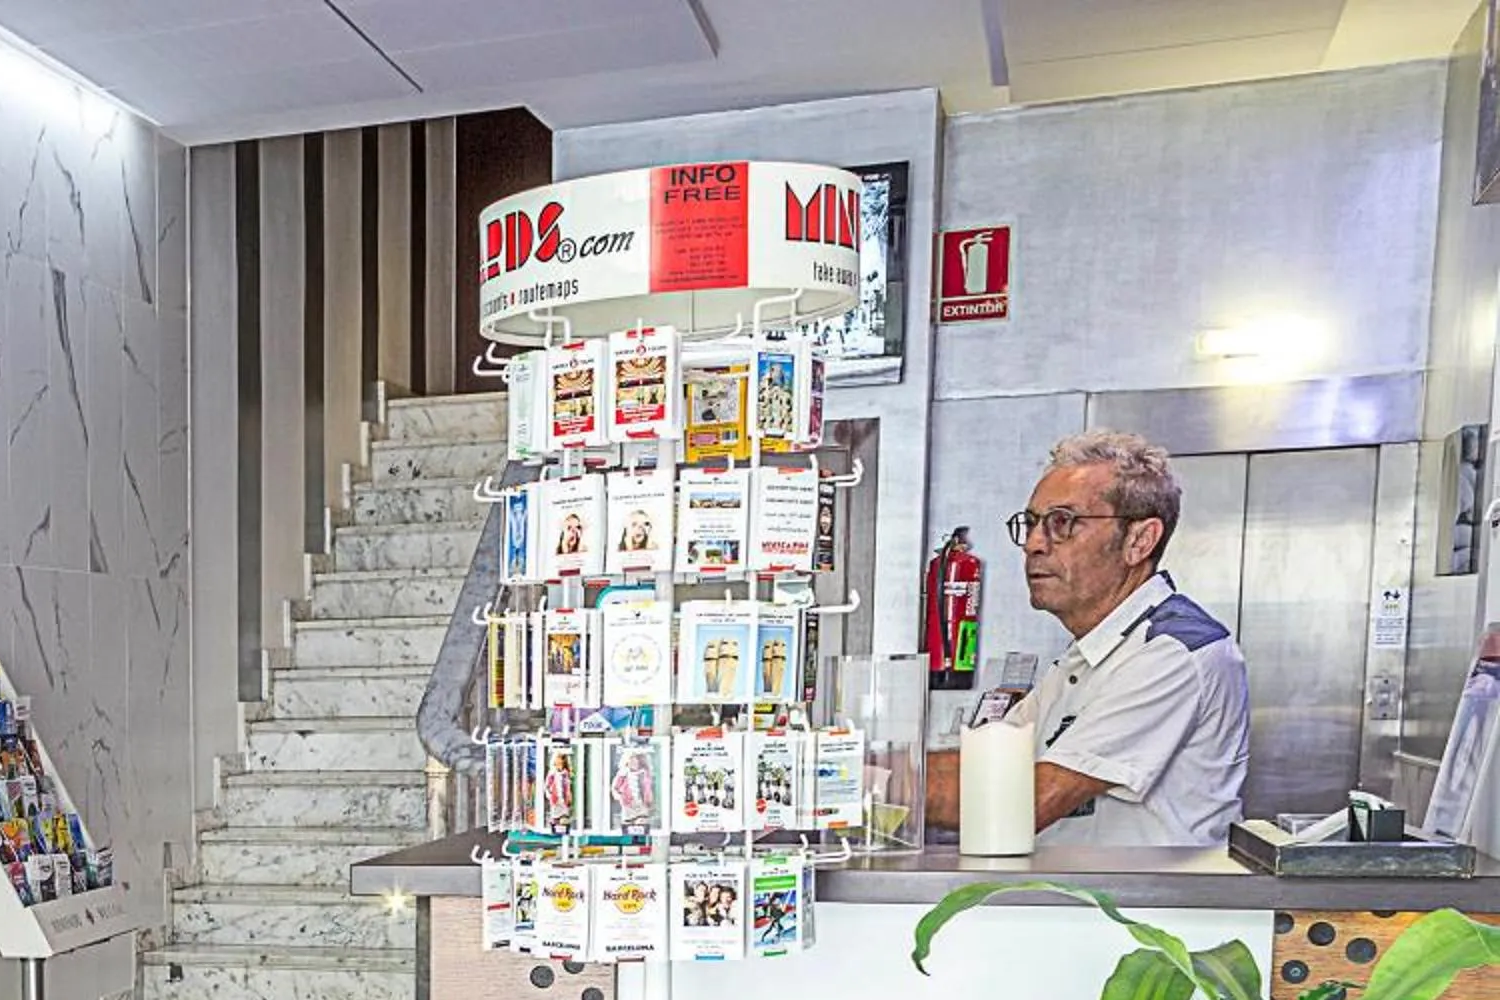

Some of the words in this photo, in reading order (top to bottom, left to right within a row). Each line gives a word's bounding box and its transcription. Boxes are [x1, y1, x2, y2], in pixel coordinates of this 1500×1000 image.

[671, 165, 736, 185] INFO
[664, 186, 740, 204] FREE
[943, 302, 1005, 317] EXTINTOR
[603, 889, 631, 901] Hard
